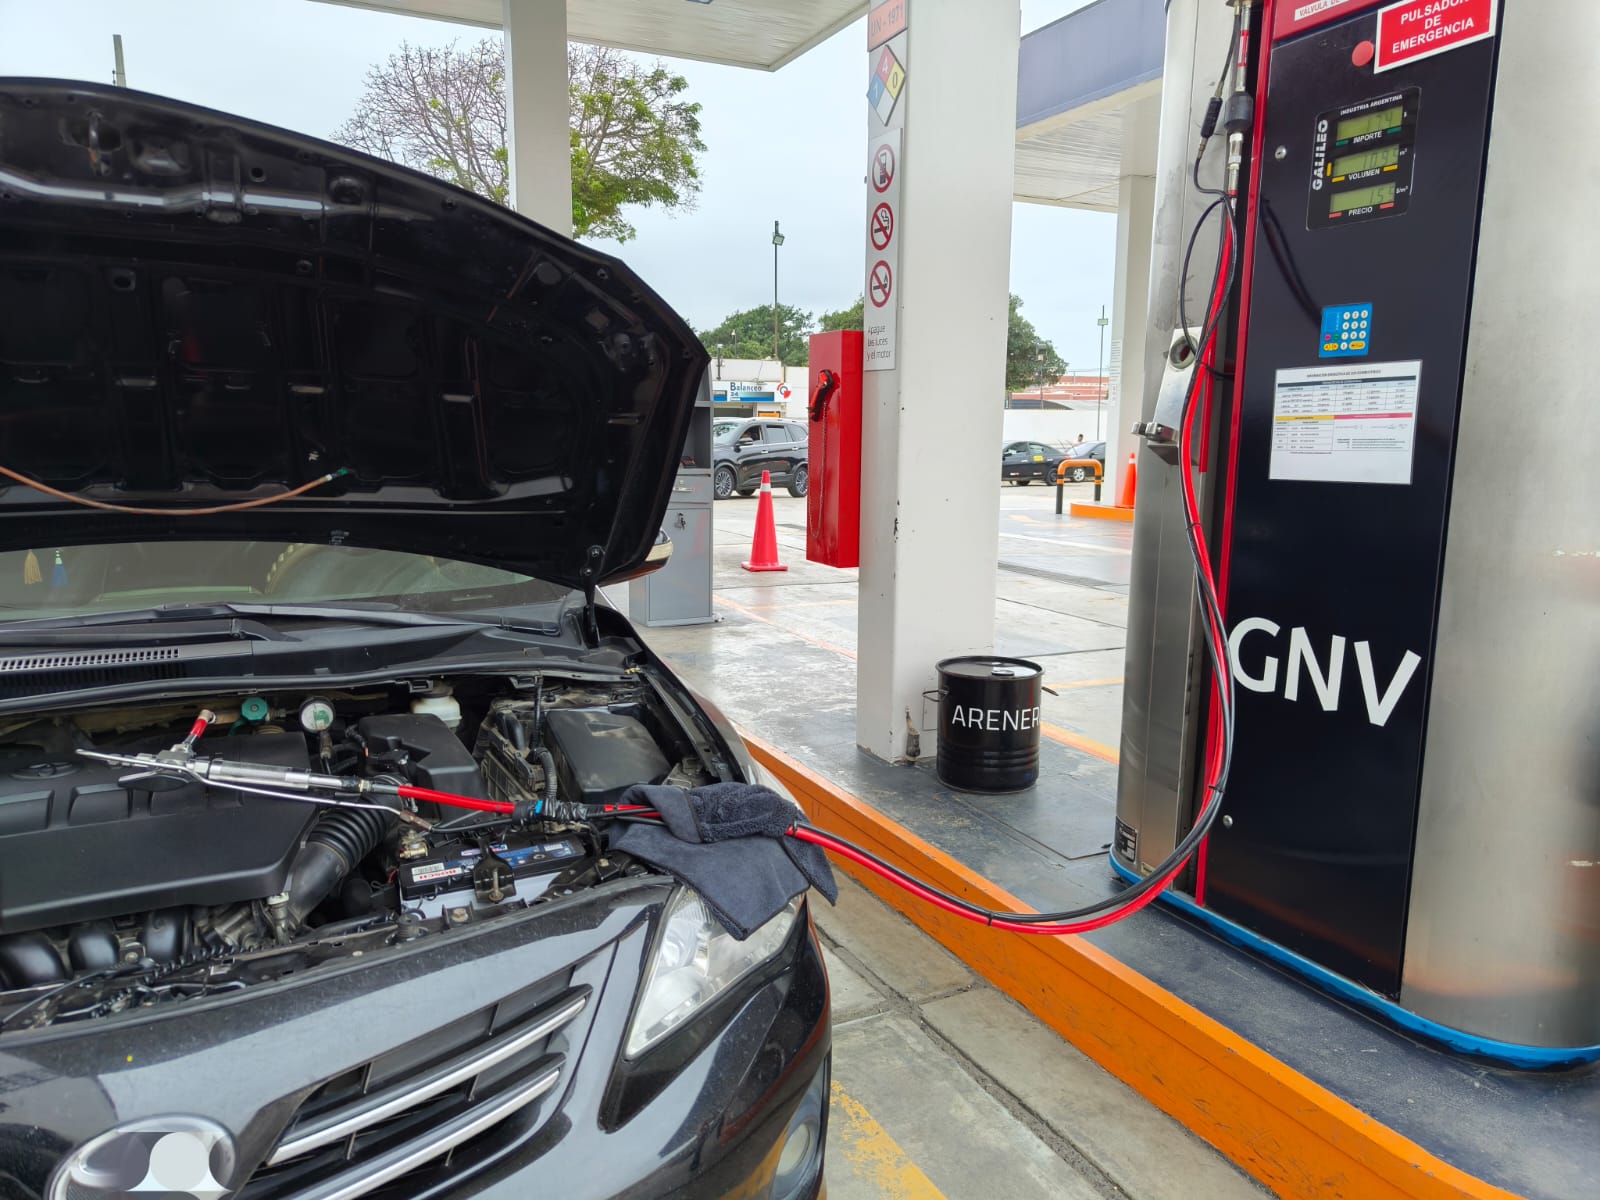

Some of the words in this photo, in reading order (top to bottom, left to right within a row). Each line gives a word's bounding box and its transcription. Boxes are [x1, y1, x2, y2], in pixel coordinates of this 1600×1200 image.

[888, 4, 904, 25] 1971
[1424, 14, 1442, 31] DE
[1391, 17, 1475, 54] EMERGENCIA
[882, 58, 888, 73] 4
[892, 71, 898, 89] 0
[873, 83, 879, 98] 1
[1340, 102, 1369, 116] INDUSTRIA
[1370, 93, 1403, 109] ARGENTINA
[1353, 131, 1383, 144] IMPORTE
[1312, 119, 1328, 191] GALILEO
[1348, 168, 1381, 182] VOLUMEN
[1348, 206, 1373, 217] PRECIO
[730, 382, 762, 392] Balanceo
[1229, 616, 1422, 728] GNV
